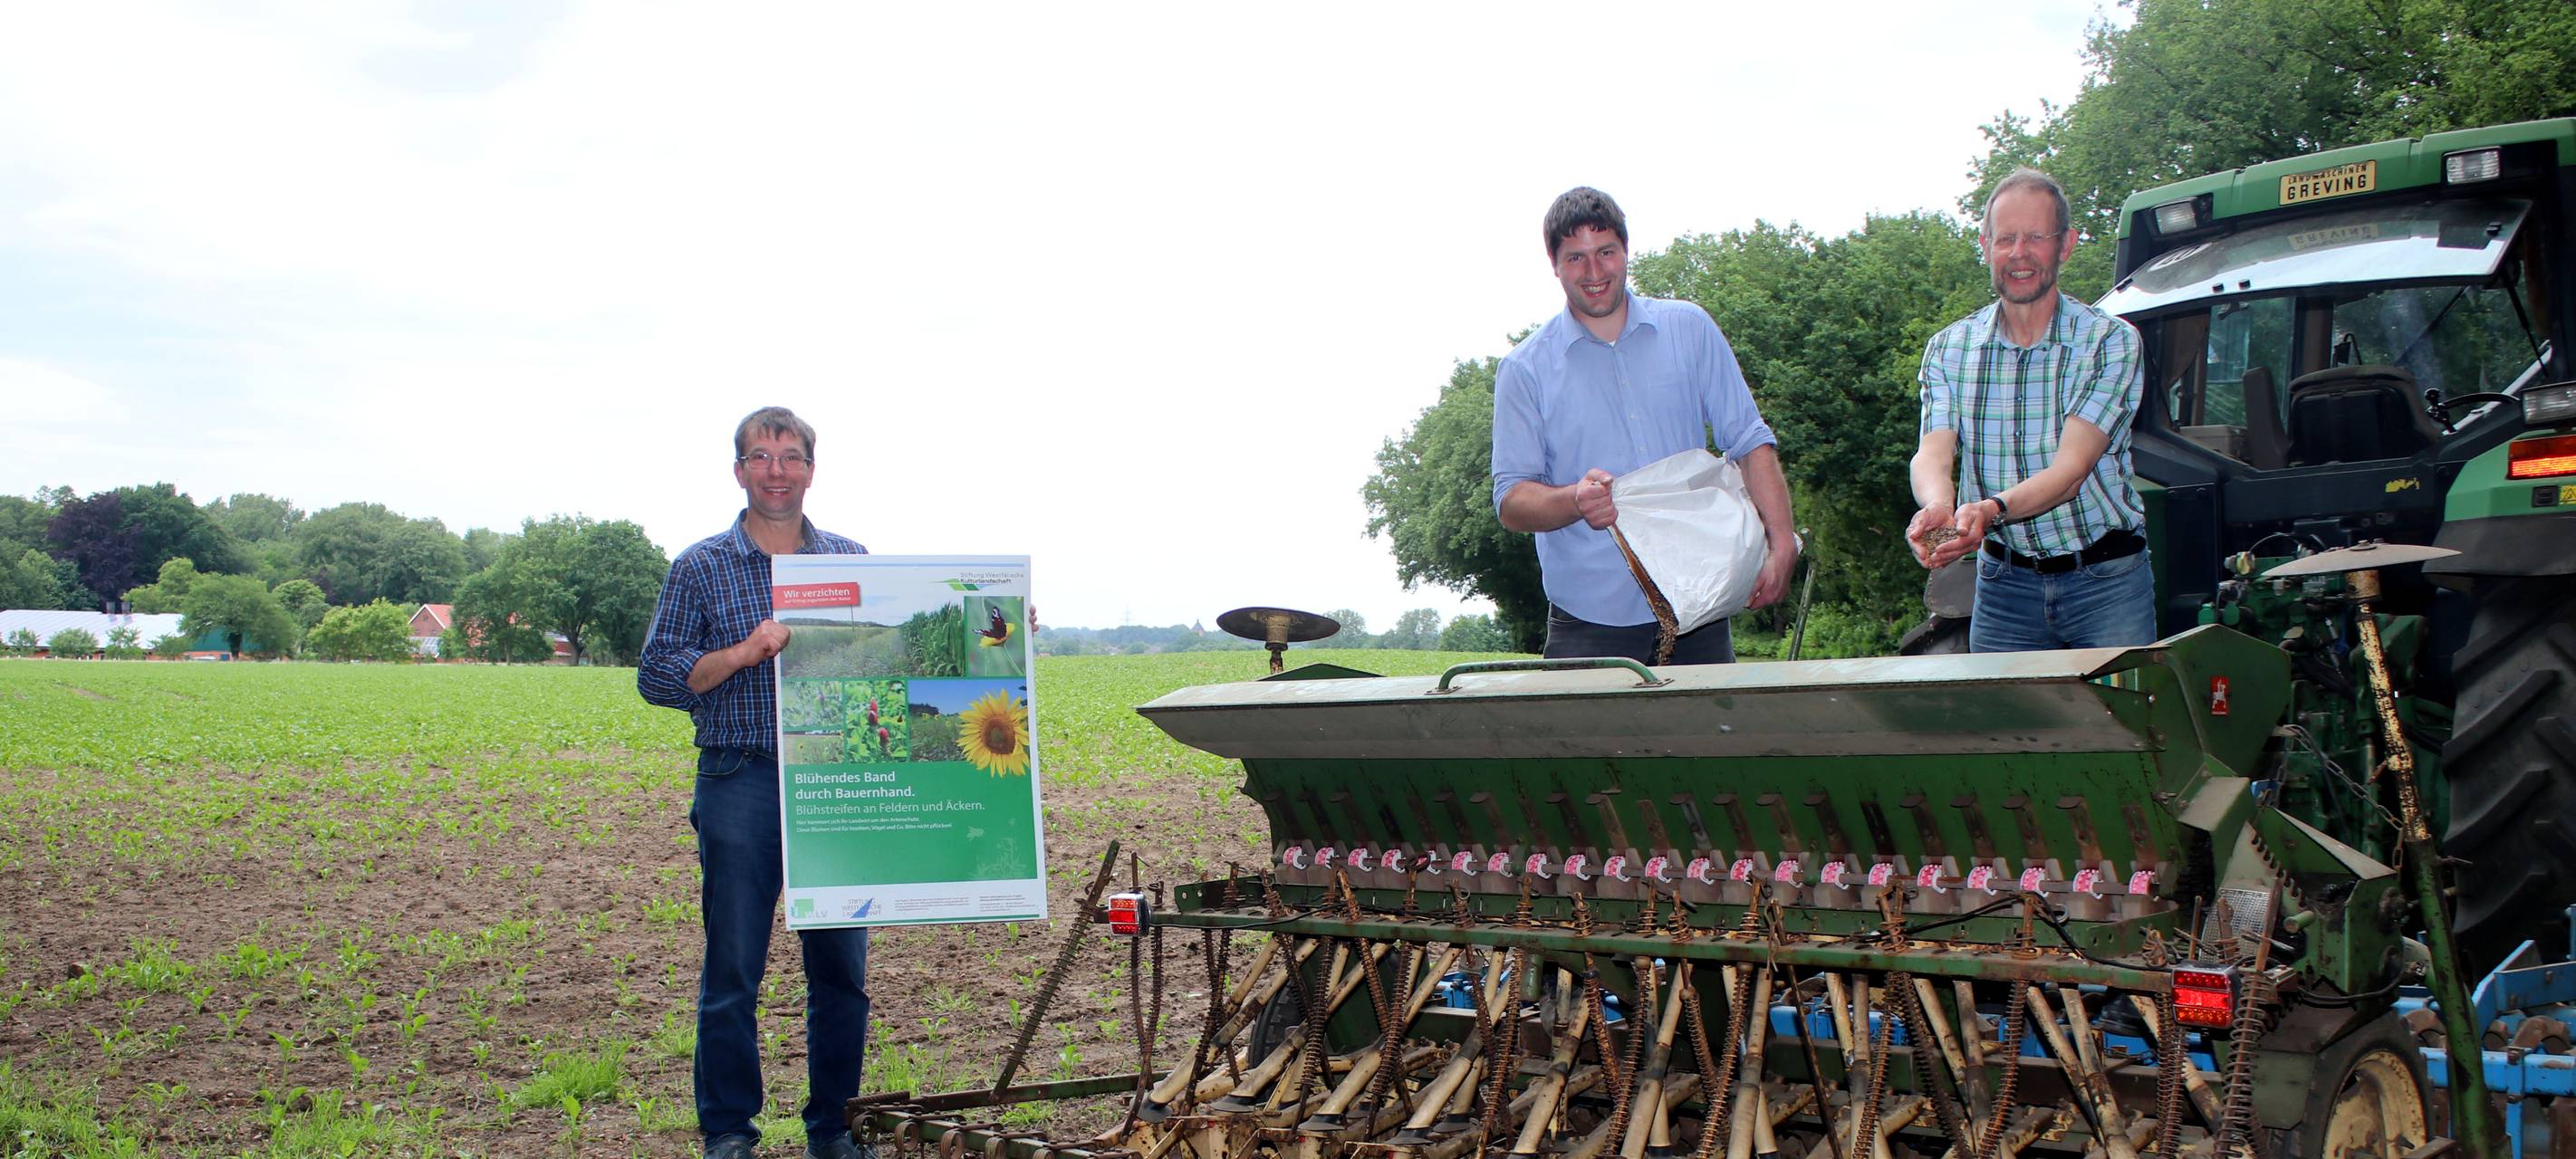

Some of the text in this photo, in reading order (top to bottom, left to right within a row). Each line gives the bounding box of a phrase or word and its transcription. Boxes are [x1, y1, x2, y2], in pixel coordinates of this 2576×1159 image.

[2288, 175, 2366, 200] GREVING
[783, 588, 850, 598] Wir verzichten
[795, 771, 896, 784] Blühendes Band
[795, 786, 915, 800] durch Bauernhand.
[796, 804, 860, 815] Blühstreifen
[879, 802, 918, 813] Feldern
[922, 801, 943, 811] und
[947, 800, 985, 810] Äckern.
